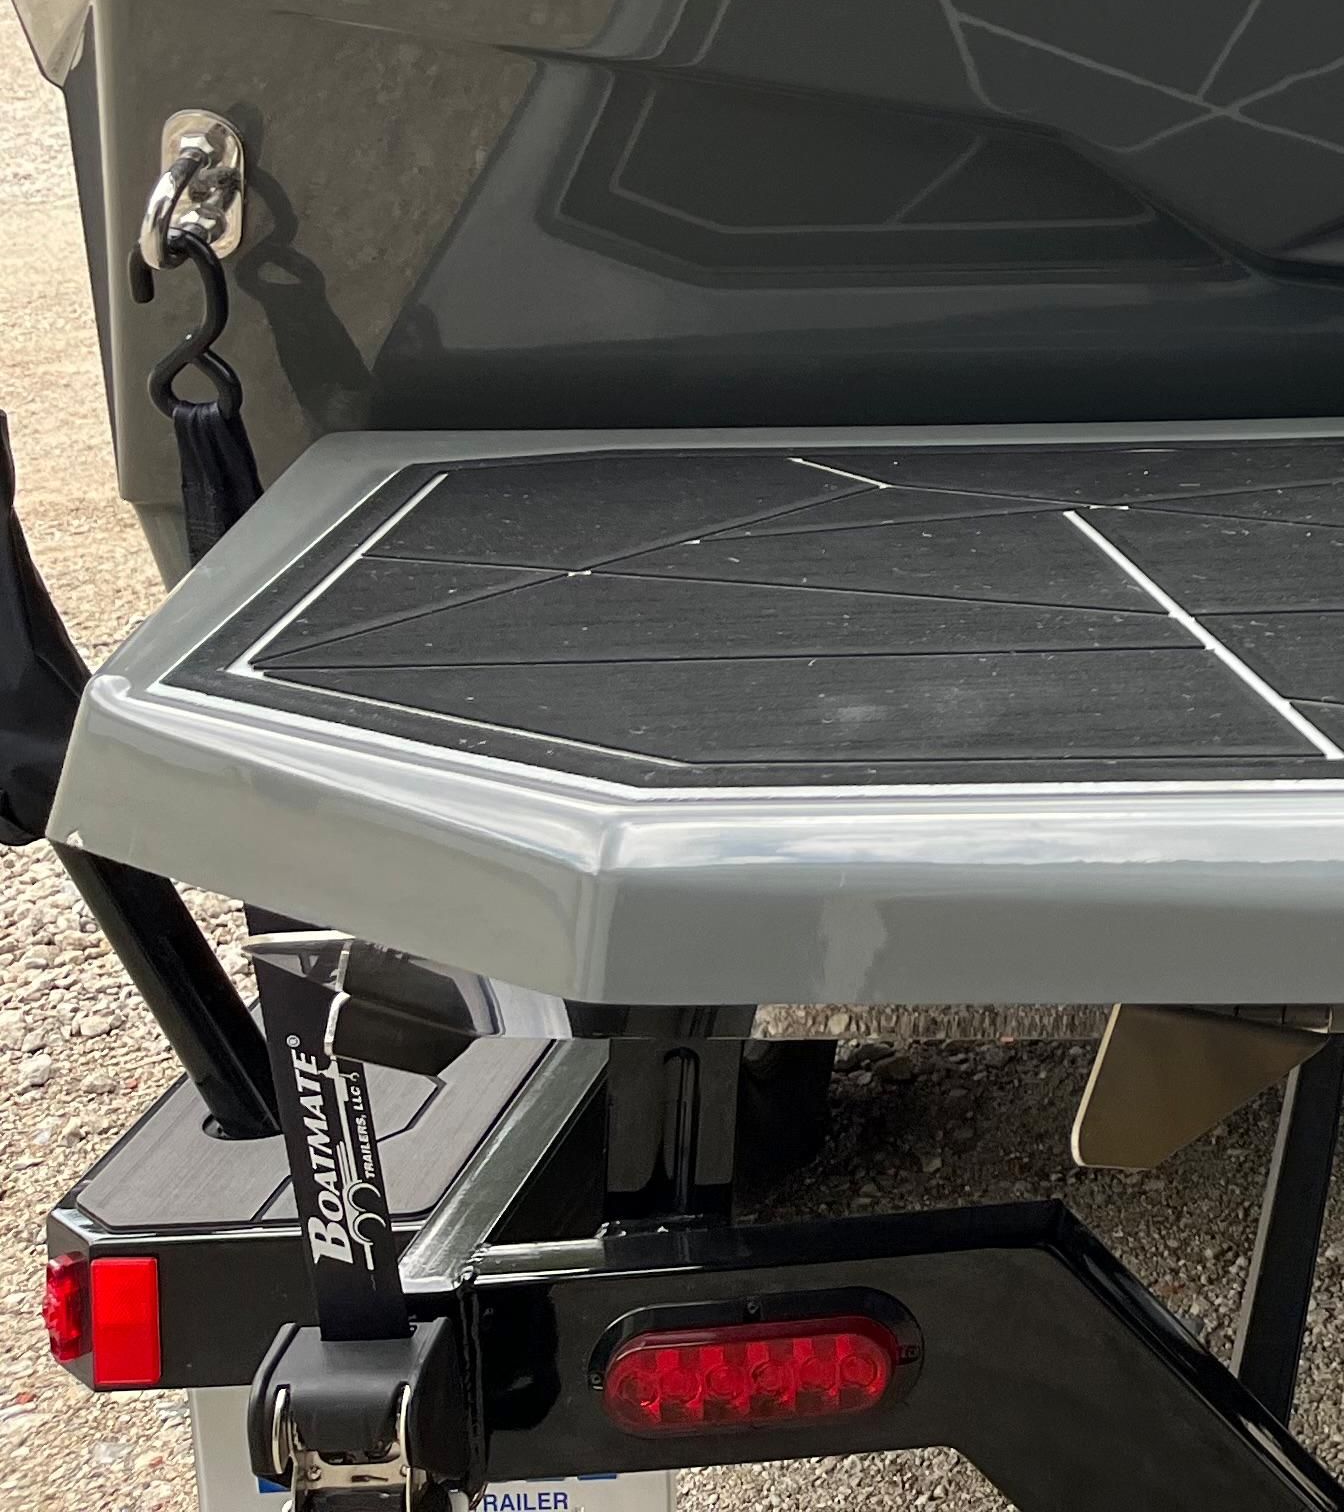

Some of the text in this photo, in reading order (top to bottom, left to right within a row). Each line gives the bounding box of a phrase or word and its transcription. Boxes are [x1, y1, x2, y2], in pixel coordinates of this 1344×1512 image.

[350, 1086, 376, 1180] TRAILERS, LLC
[483, 1492, 569, 1512] RAILER
